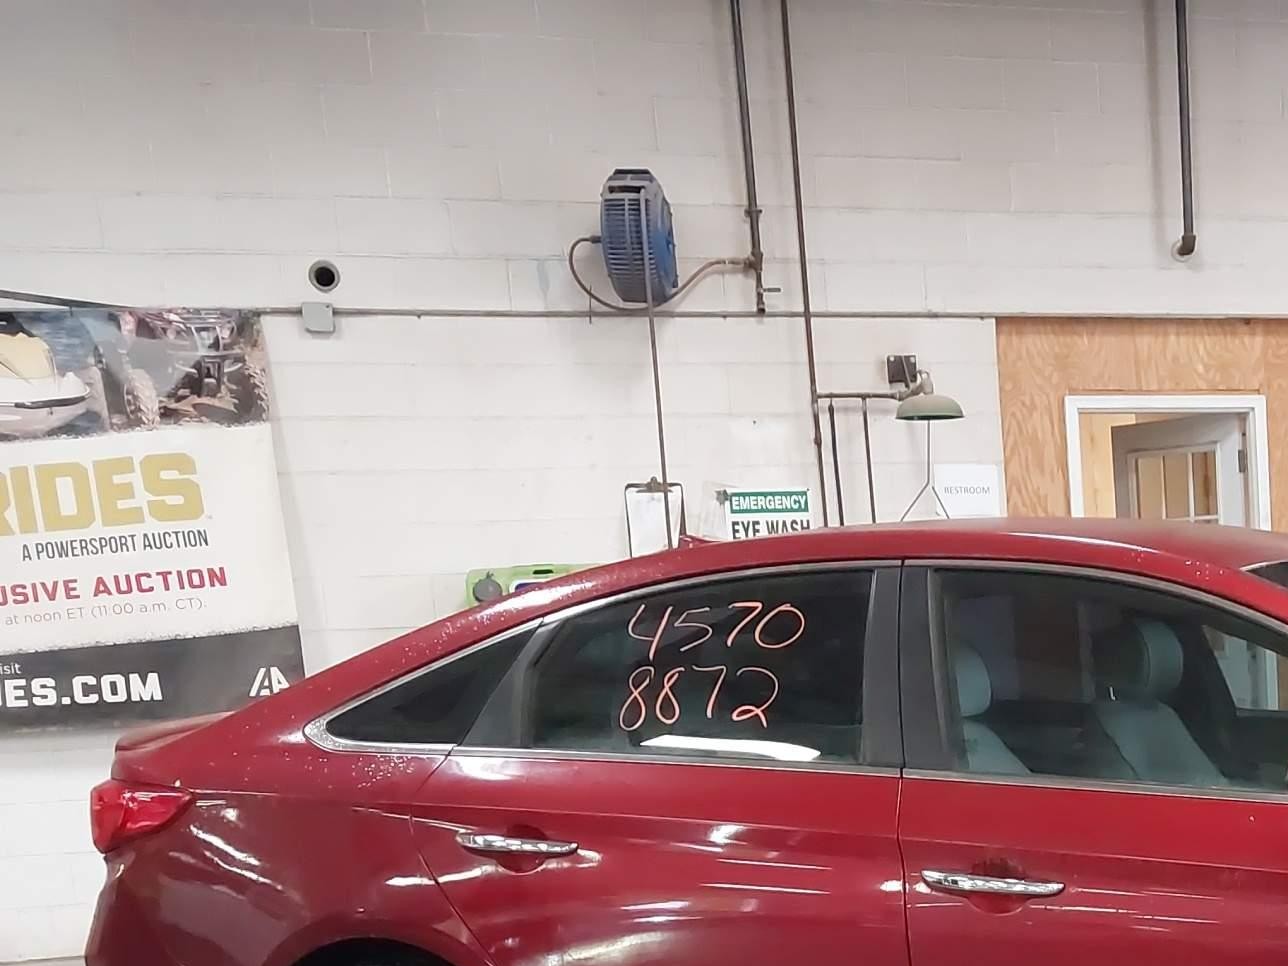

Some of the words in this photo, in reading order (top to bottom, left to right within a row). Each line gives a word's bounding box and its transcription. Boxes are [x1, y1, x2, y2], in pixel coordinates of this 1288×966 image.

[732, 495, 807, 510] EMERGENCY
[944, 486, 990, 495] RESTROOM
[732, 520, 760, 540] EYE
[22, 544, 32, 561] A
[36, 534, 137, 560] POWERSPORT
[143, 529, 208, 550] AUCTION
[93, 567, 228, 597] AUCTION
[5, 614, 20, 626] at
[24, 610, 62, 624] noon
[66, 605, 85, 619] ET
[628, 601, 805, 661] 4570
[619, 665, 779, 732] 8872
